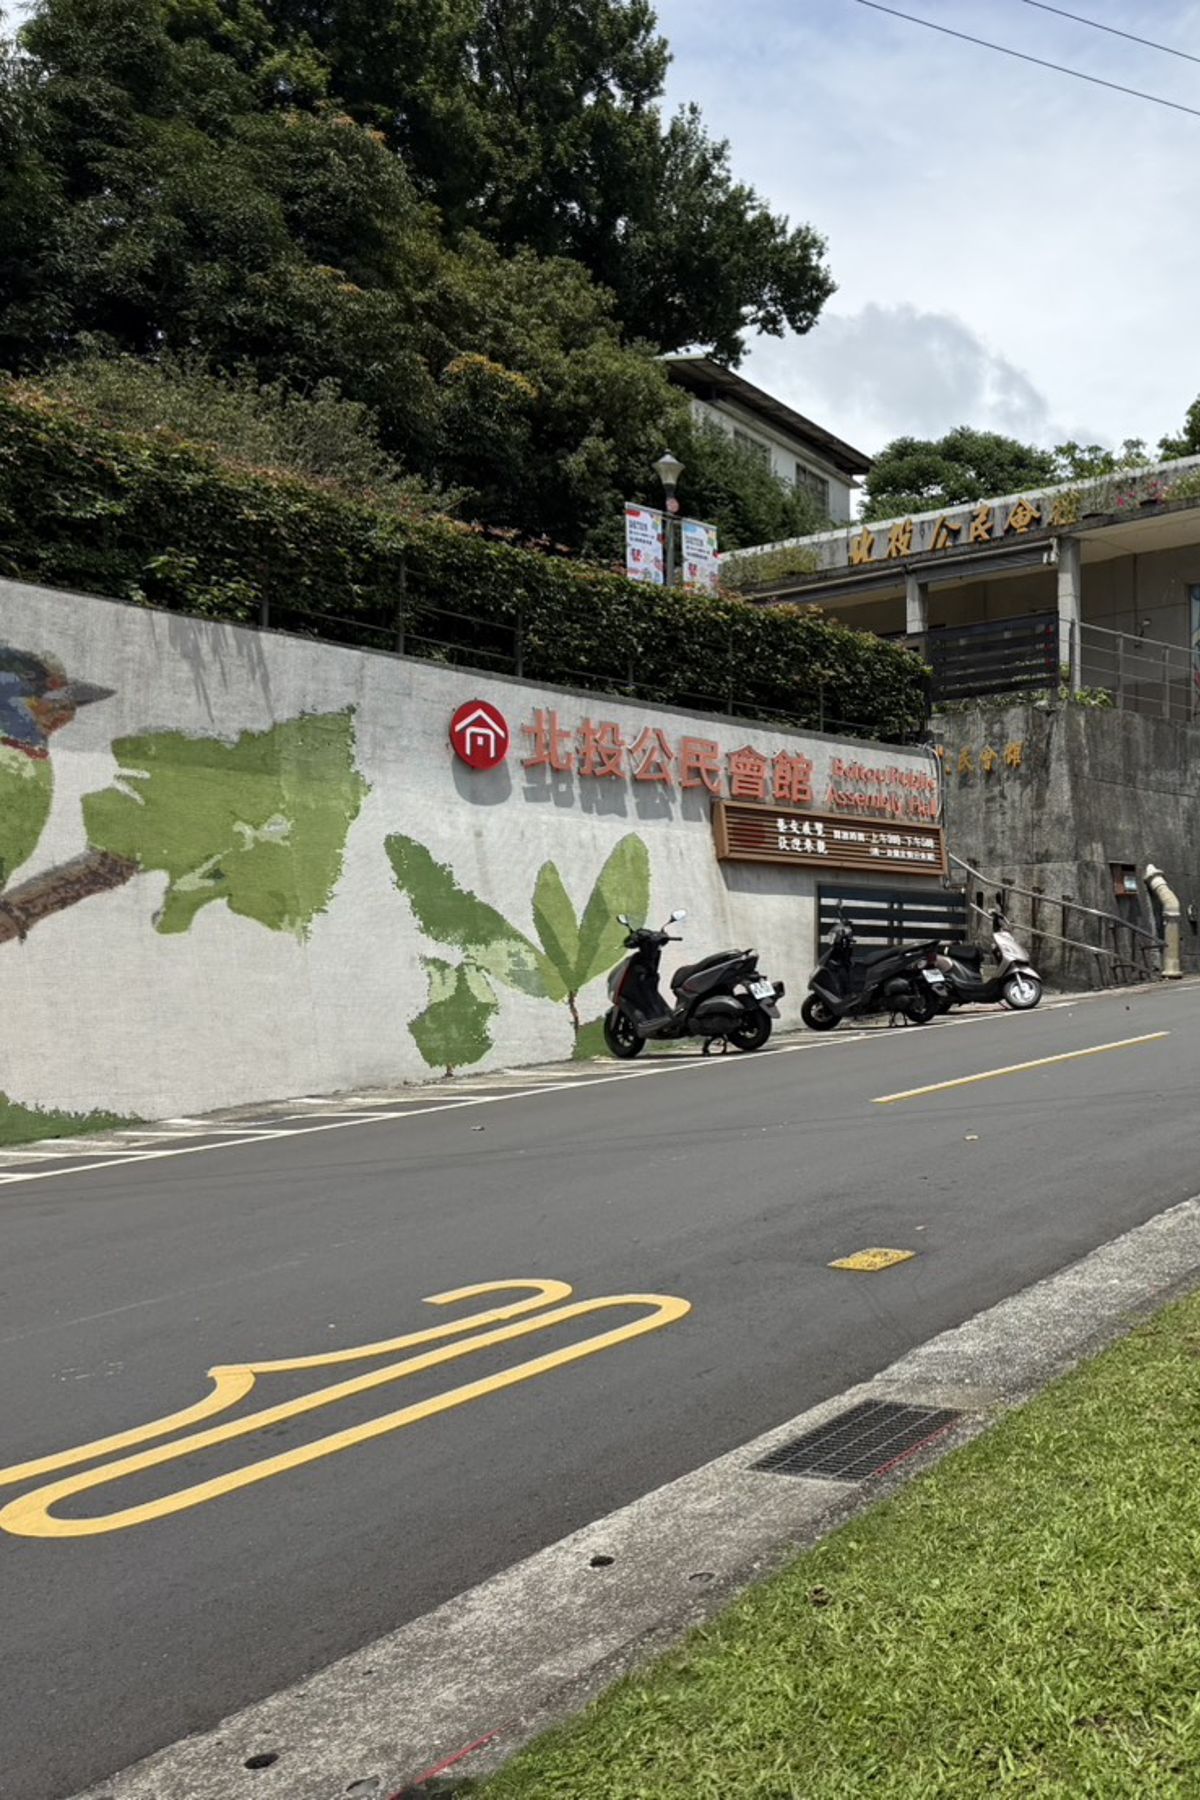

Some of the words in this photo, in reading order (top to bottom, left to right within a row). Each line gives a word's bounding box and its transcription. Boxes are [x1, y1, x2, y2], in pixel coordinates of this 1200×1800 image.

[520, 706, 814, 804] 北投公民會館
